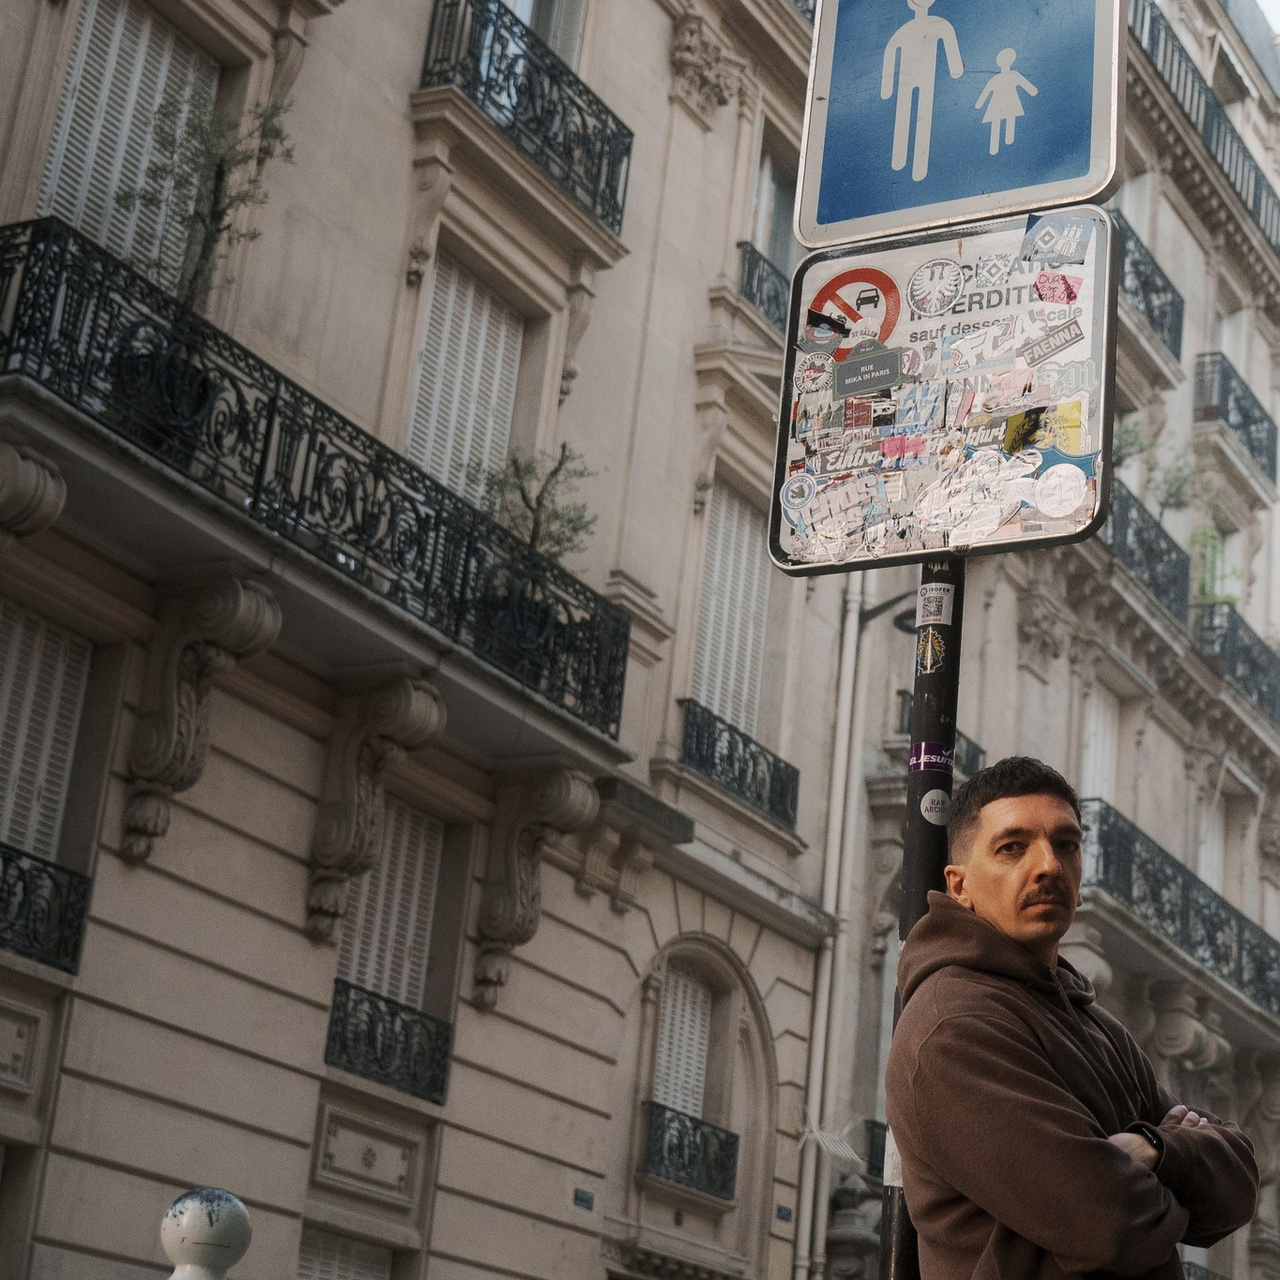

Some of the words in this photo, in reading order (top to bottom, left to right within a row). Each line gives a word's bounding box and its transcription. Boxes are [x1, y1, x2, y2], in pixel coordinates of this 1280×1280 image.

[909, 324, 947, 344] sauf
[951, 314, 1014, 336] desse
[1046, 304, 1083, 323] cale
[1023, 323, 1083, 365] FAENNA
[844, 375, 862, 385] MIKA
[863, 373, 871, 381] IN
[871, 368, 890, 379] PARIS
[860, 363, 874, 373] RUE
[826, 447, 883, 470] Eintra
[909, 756, 917, 766] EL
